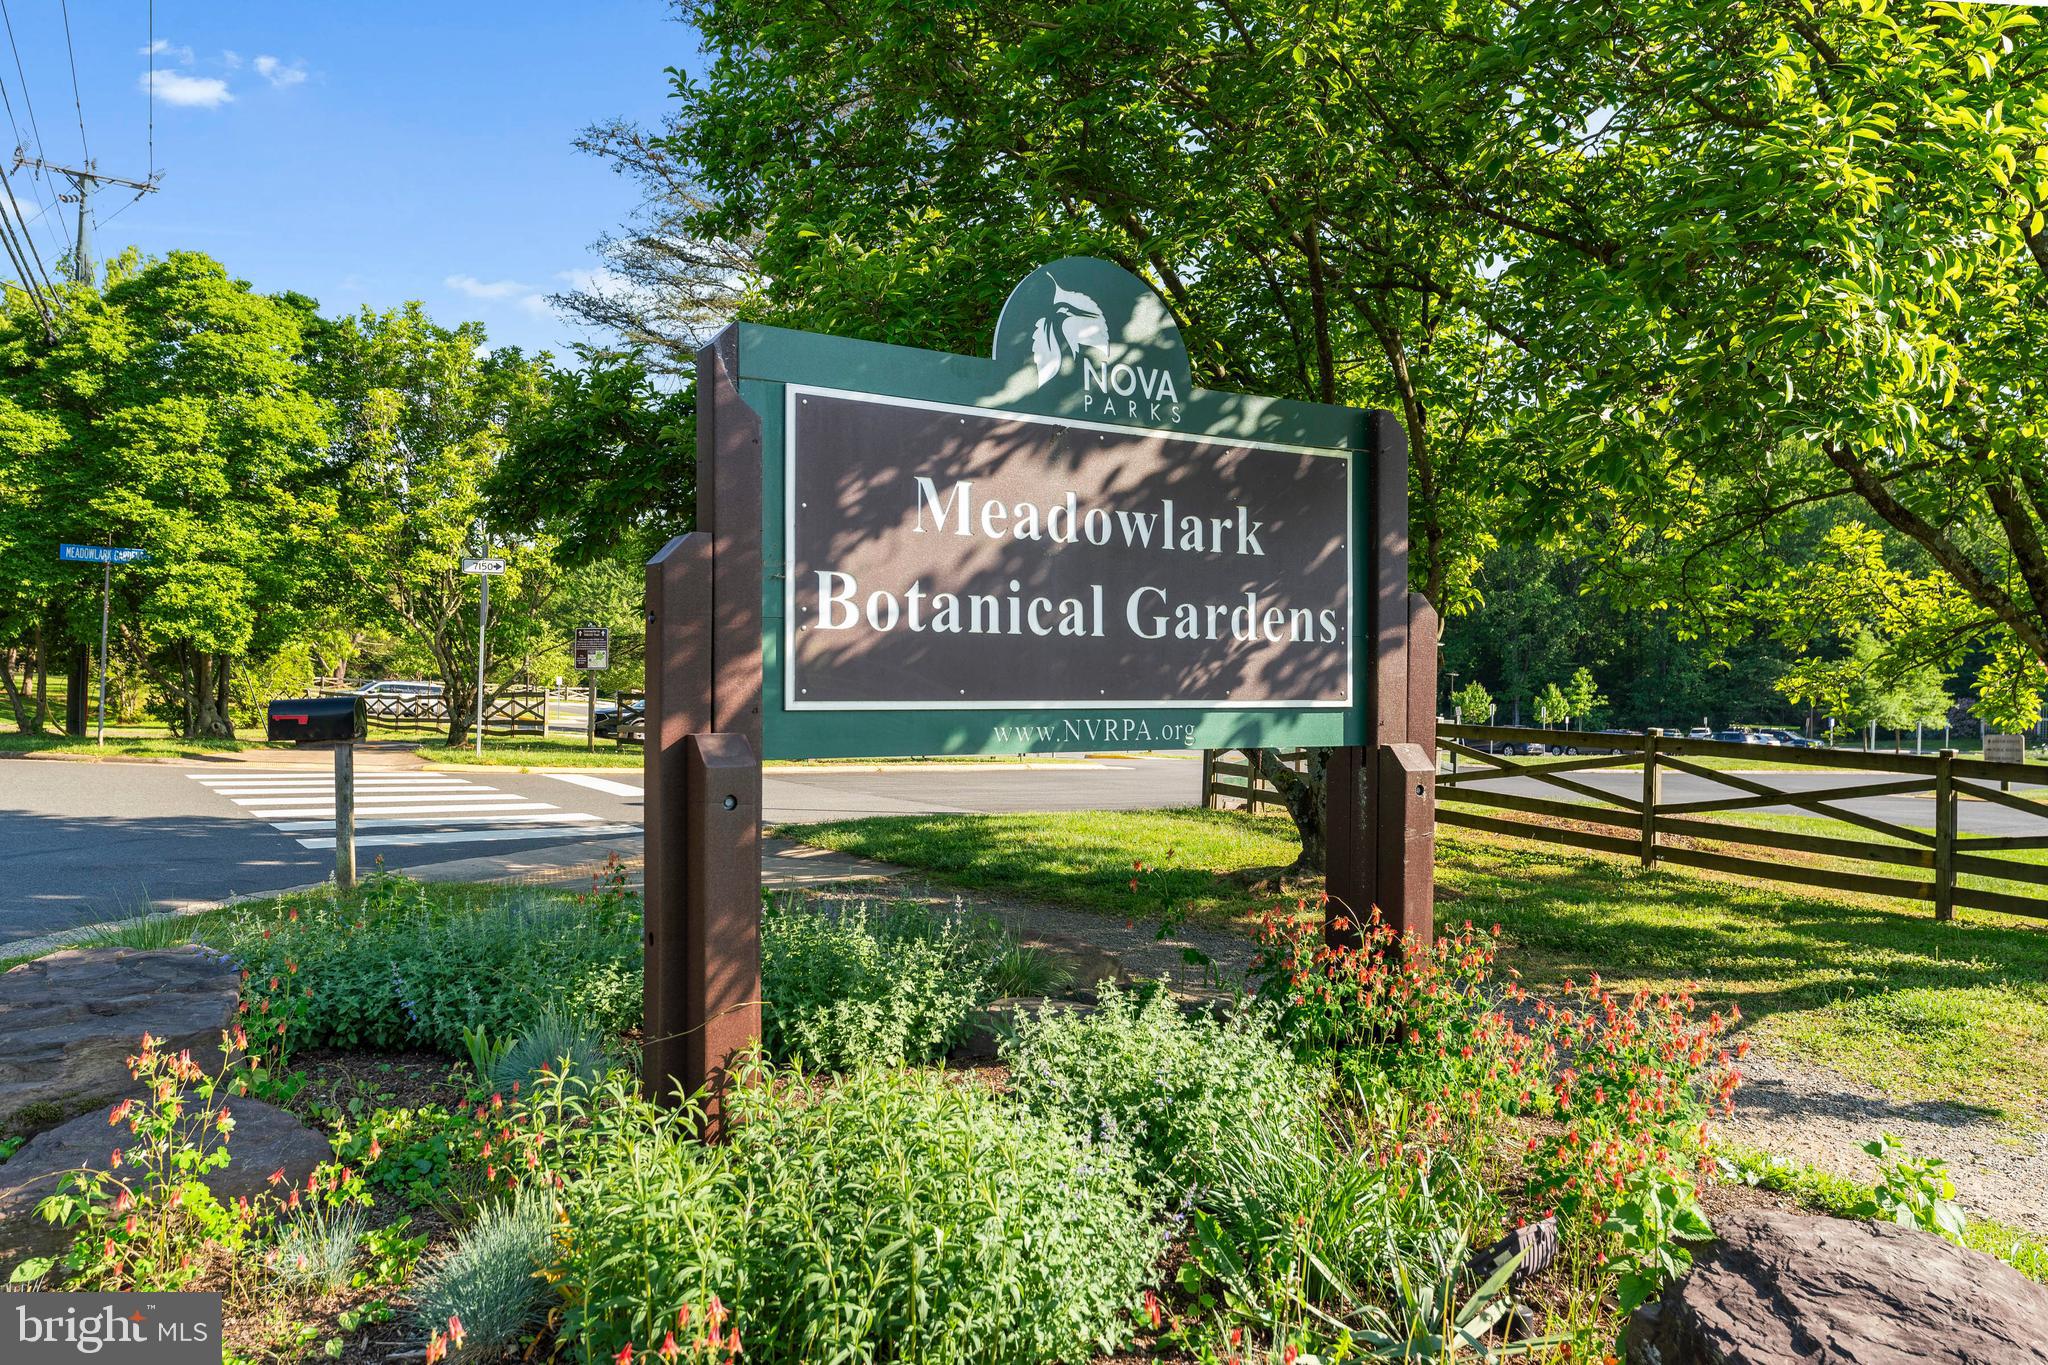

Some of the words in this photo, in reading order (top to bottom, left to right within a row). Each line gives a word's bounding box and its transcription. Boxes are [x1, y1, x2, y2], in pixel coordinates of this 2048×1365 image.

[1083, 357, 1179, 404] NOVA
[1084, 394, 1181, 424] PARKS
[912, 475, 1266, 557] Meadowlark
[66, 546, 112, 560] MEADOWLARK
[472, 562, 494, 570] 7150
[814, 569, 1106, 638] Botanical
[1126, 585, 1339, 645] Gardens
[993, 718, 1196, 747] www.NVRPA.org
